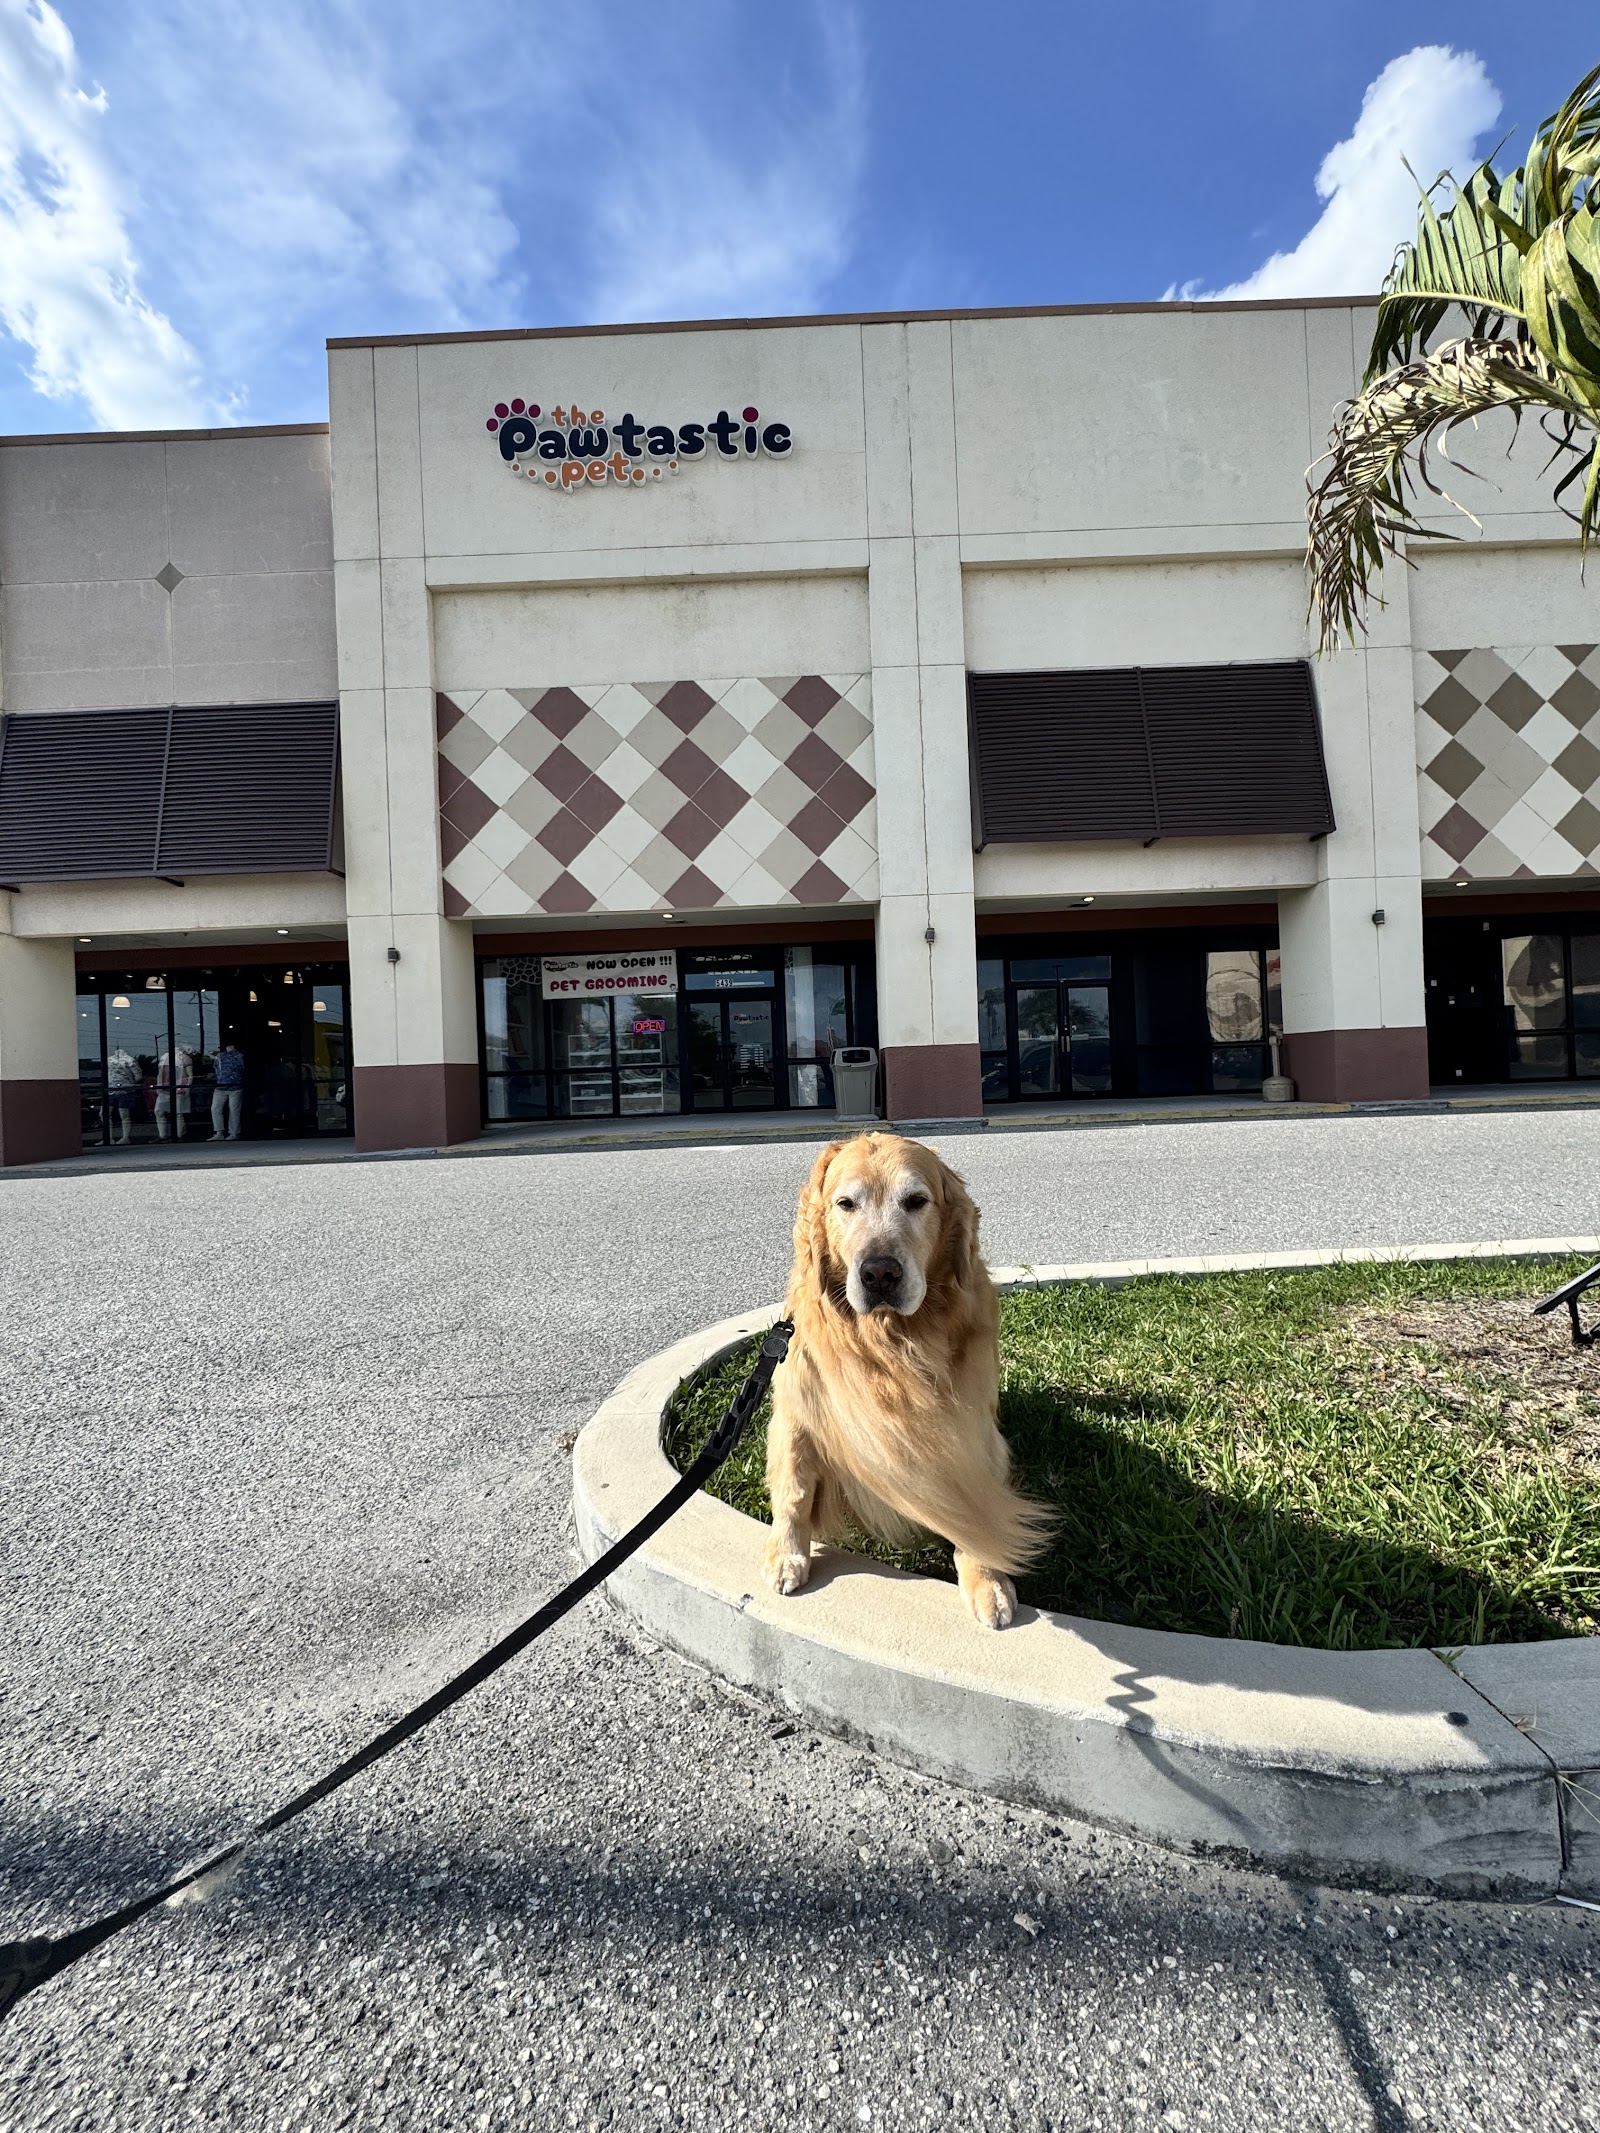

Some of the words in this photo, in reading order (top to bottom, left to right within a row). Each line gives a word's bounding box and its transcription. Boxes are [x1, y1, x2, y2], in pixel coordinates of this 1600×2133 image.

[551, 404, 605, 427] the
[499, 407, 793, 463] Pawtastic
[561, 451, 632, 489] pet
[586, 960, 617, 970] NOW
[620, 957, 656, 968] OPEN
[660, 955, 672, 966] !!!
[550, 980, 580, 992] PET
[585, 975, 668, 990] GROOMING
[716, 979, 733, 987] 5439
[635, 1021, 663, 1031] OPEN
